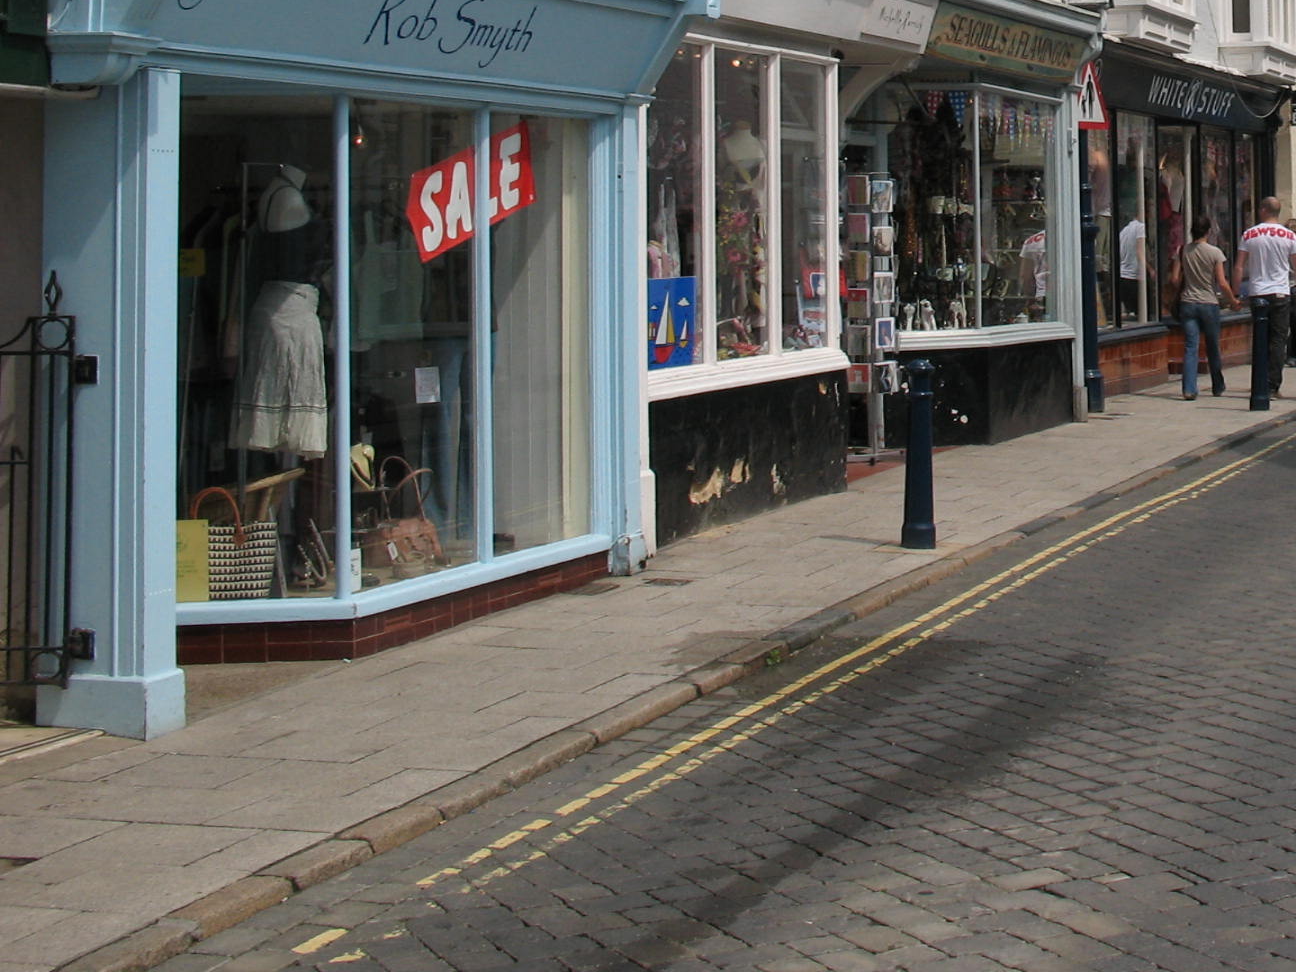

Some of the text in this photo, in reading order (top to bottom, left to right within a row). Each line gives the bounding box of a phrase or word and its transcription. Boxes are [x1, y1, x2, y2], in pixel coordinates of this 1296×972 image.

[944, 13, 1010, 53] SEAGULLS
[1015, 30, 1074, 68] FLAMINGOS
[1148, 75, 1235, 117] WHITE STUFF
